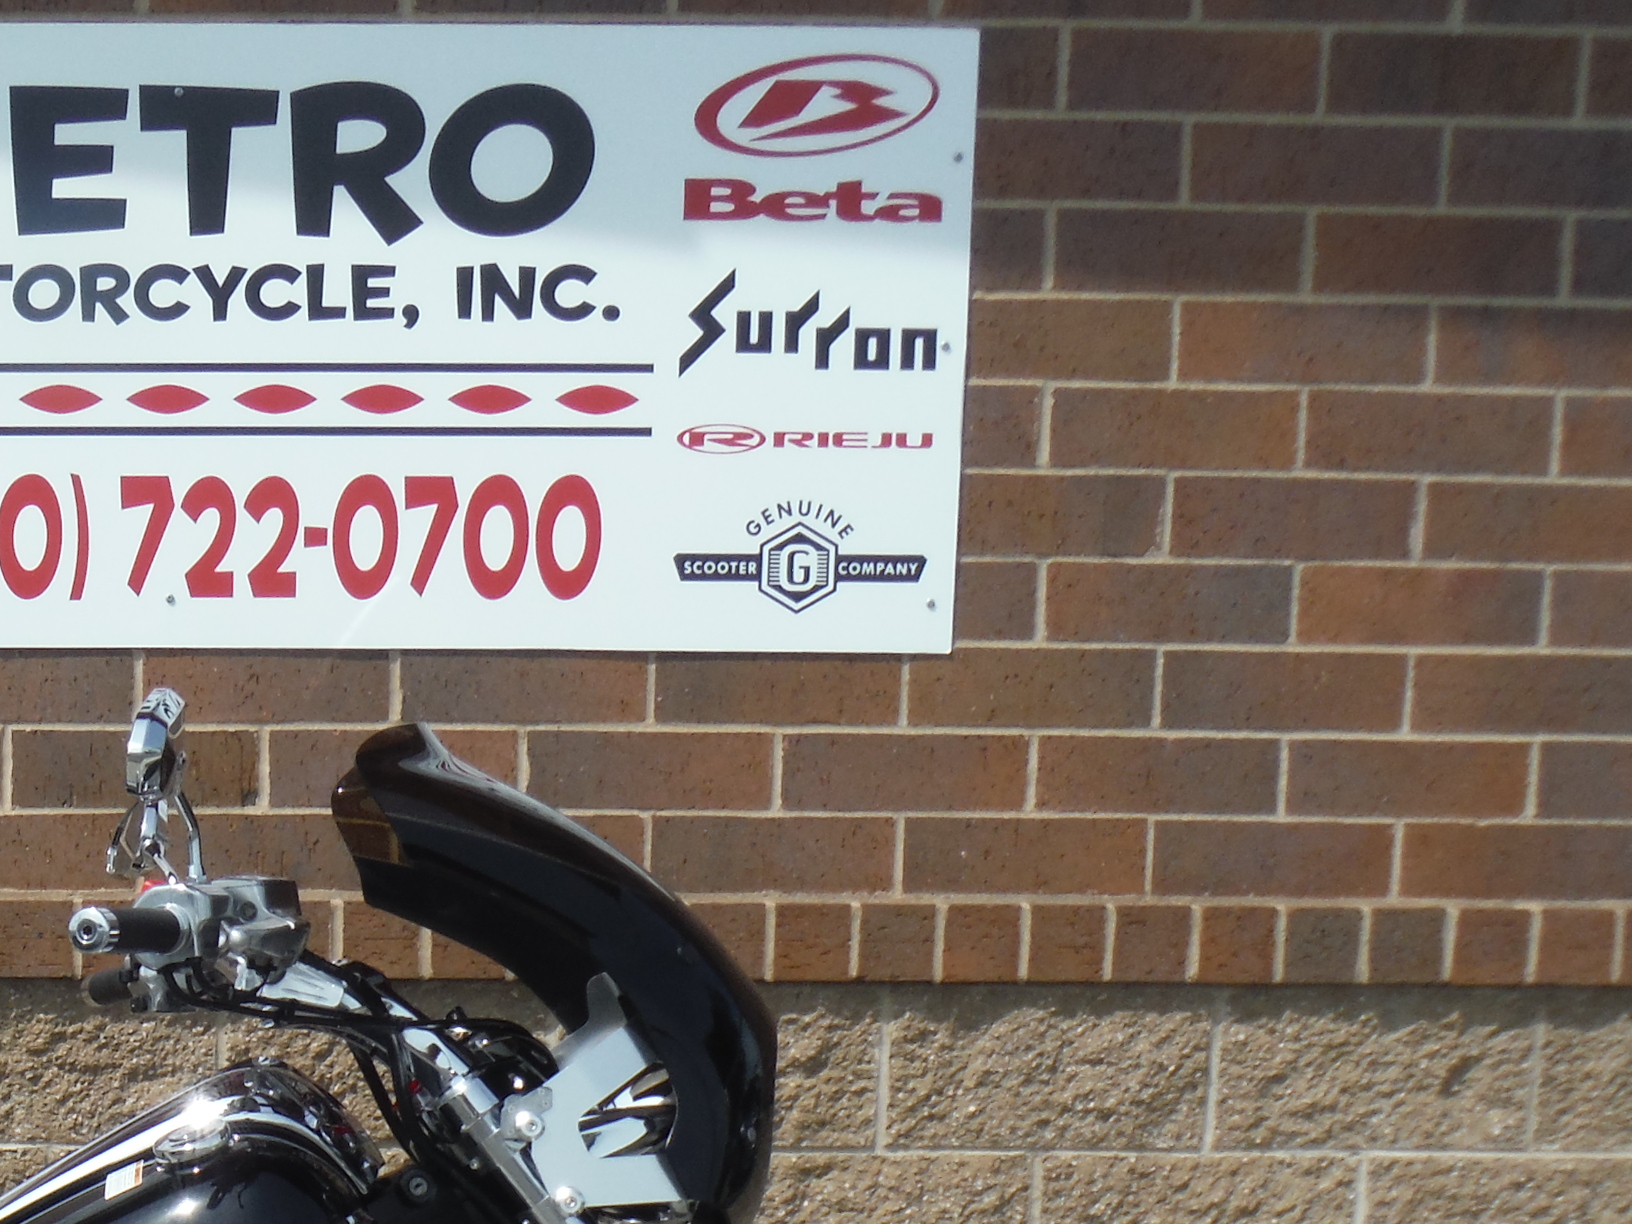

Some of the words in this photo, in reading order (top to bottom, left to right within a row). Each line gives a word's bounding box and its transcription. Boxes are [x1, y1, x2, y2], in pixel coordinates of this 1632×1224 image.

[683, 178, 943, 223] Beta
[456, 263, 621, 323] INC.
[773, 431, 934, 449] RIEJU
[120, 474, 603, 600] 722-0700
[745, 500, 855, 541] GENUINE
[683, 560, 758, 576] SCOOTER
[837, 561, 919, 577] COMPANY
